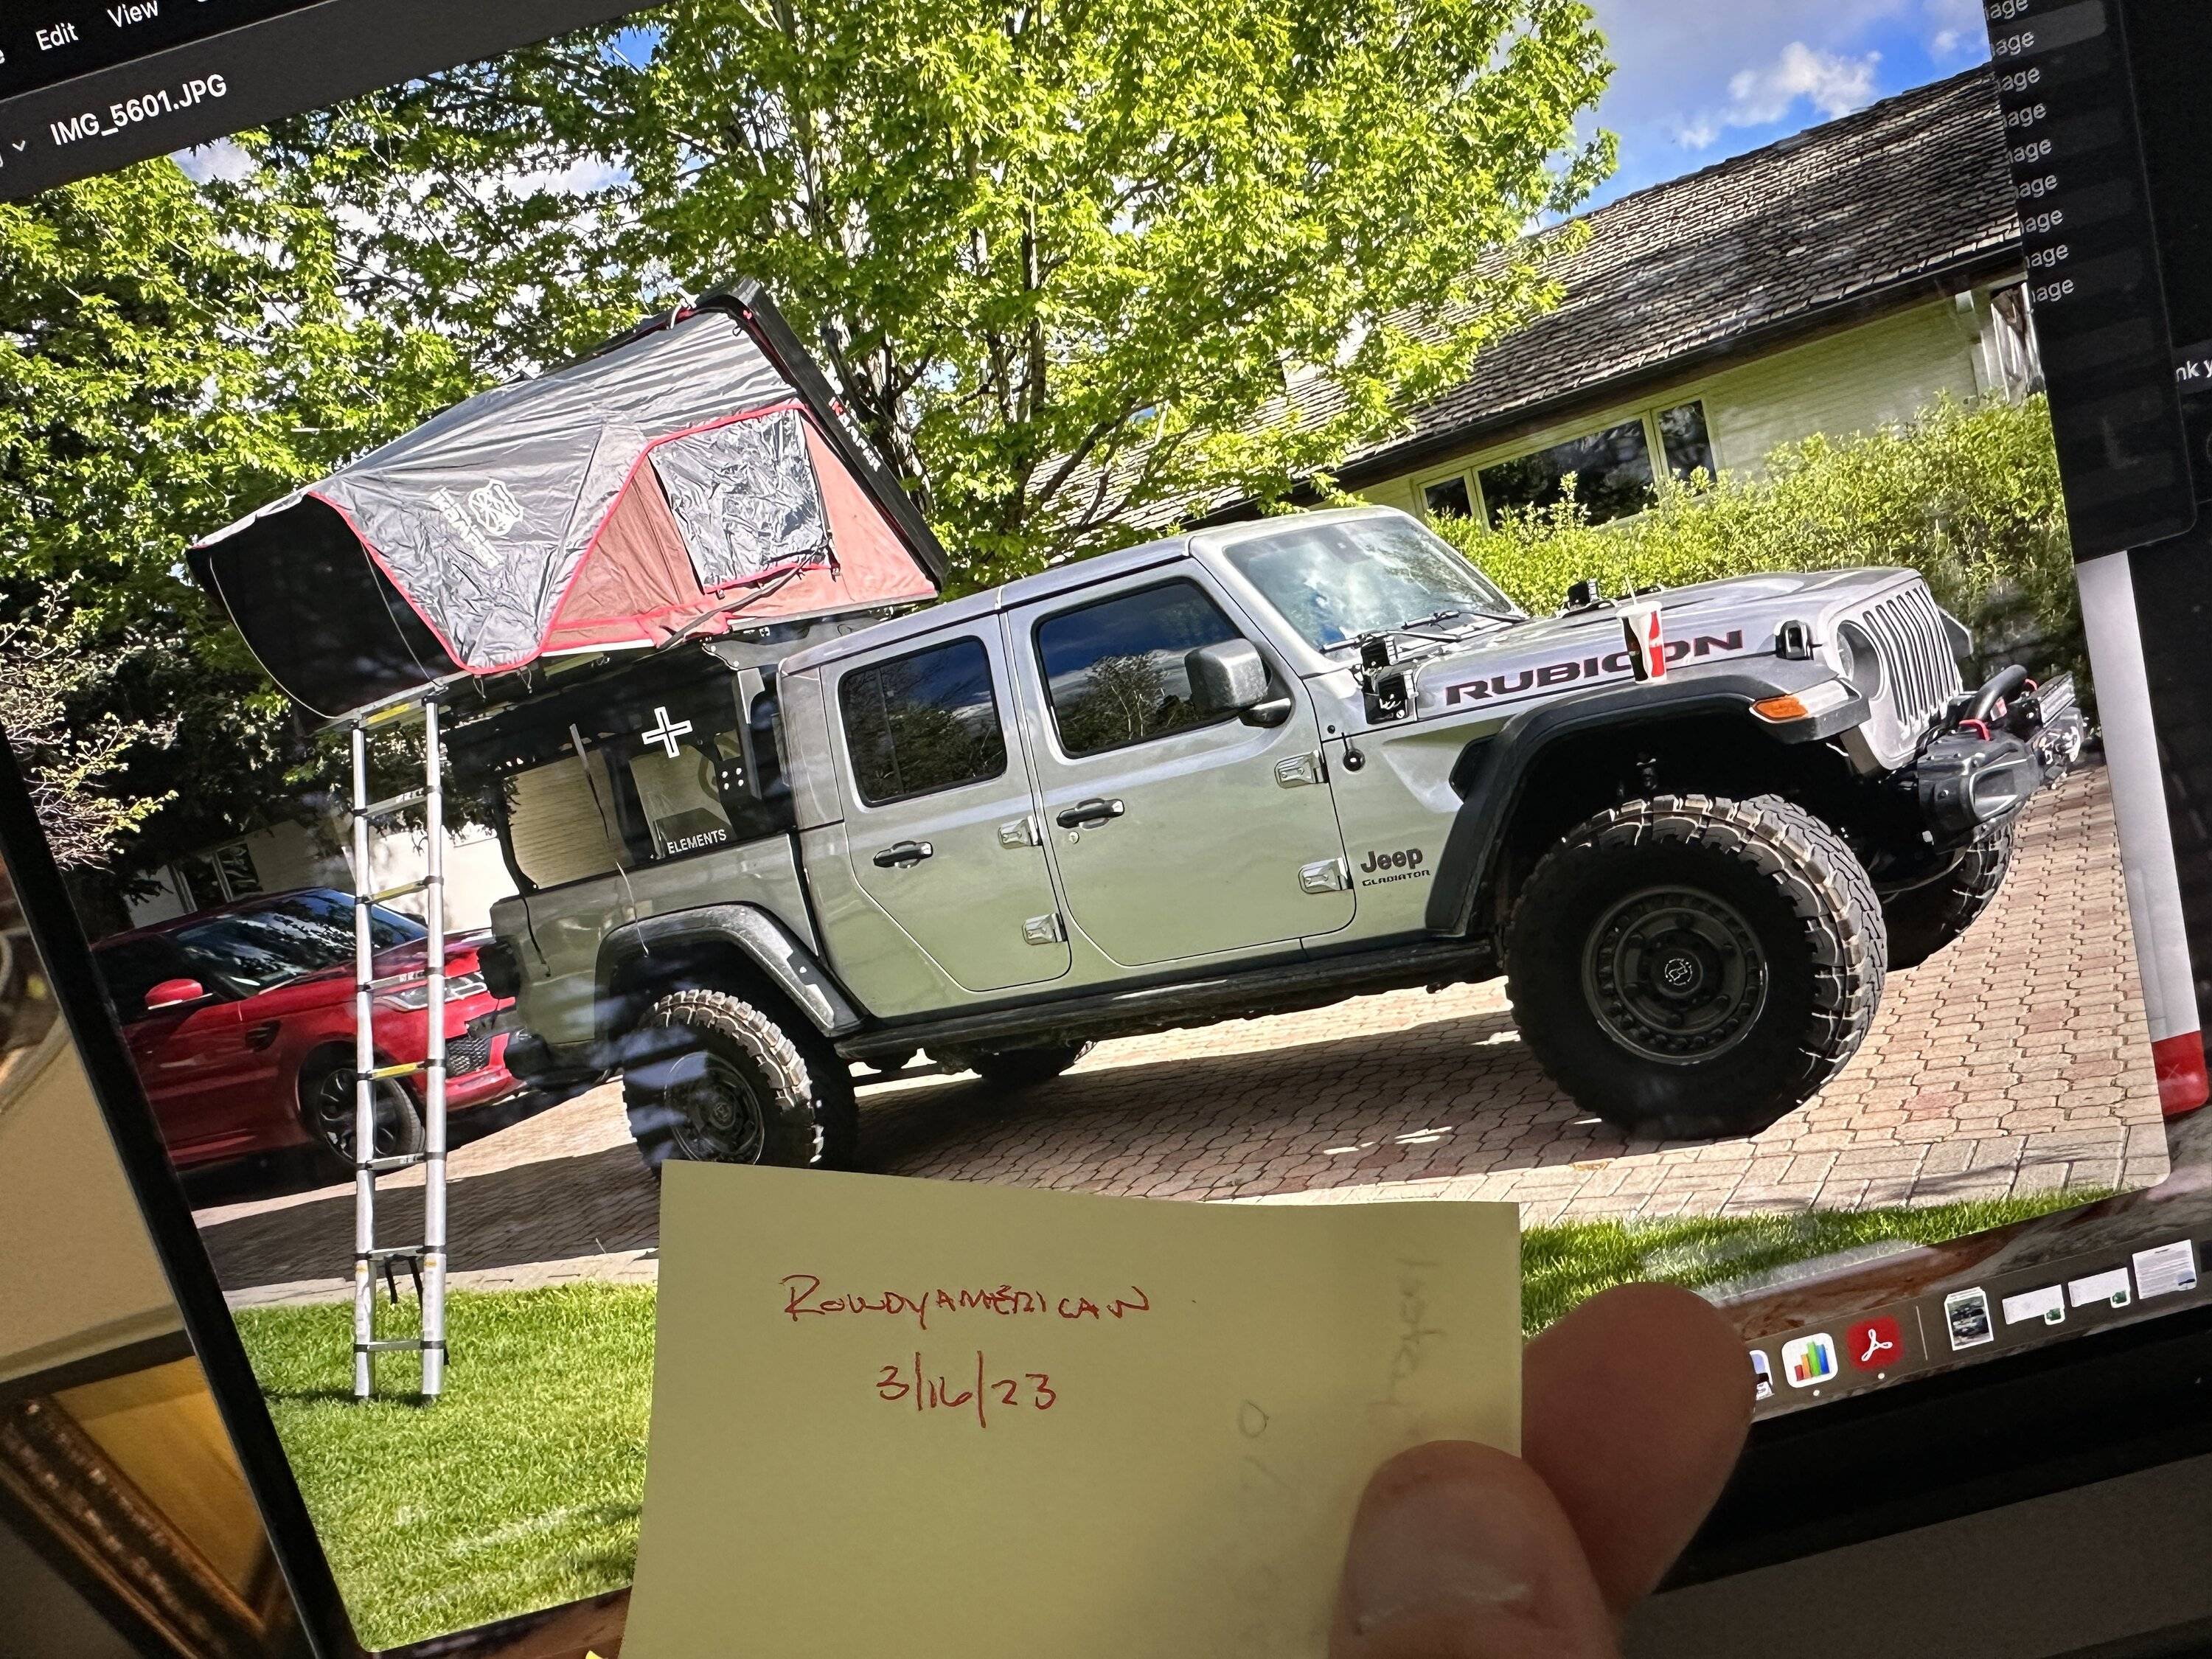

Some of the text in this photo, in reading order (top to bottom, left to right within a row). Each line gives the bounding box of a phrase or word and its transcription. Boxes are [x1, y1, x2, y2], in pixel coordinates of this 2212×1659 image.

[1985, 0, 2029, 20] age
[35, 0, 159, 50] Edit View
[1992, 32, 2035, 56] age
[1995, 67, 2041, 92] age
[50, 74, 227, 146] IMG_5601.JPG
[2003, 103, 2047, 128] age
[2014, 175, 2058, 199] age
[2020, 210, 2063, 234] age
[2025, 244, 2069, 268] age
[2031, 279, 2075, 303] age
[1446, 630, 1743, 706] RUBICON
[667, 829, 727, 855] ELEMENTS
[1360, 848, 1423, 873] Jeep
[1362, 869, 1431, 886] GLADIATOR
[876, 1350, 1057, 1428] 3/16/23
